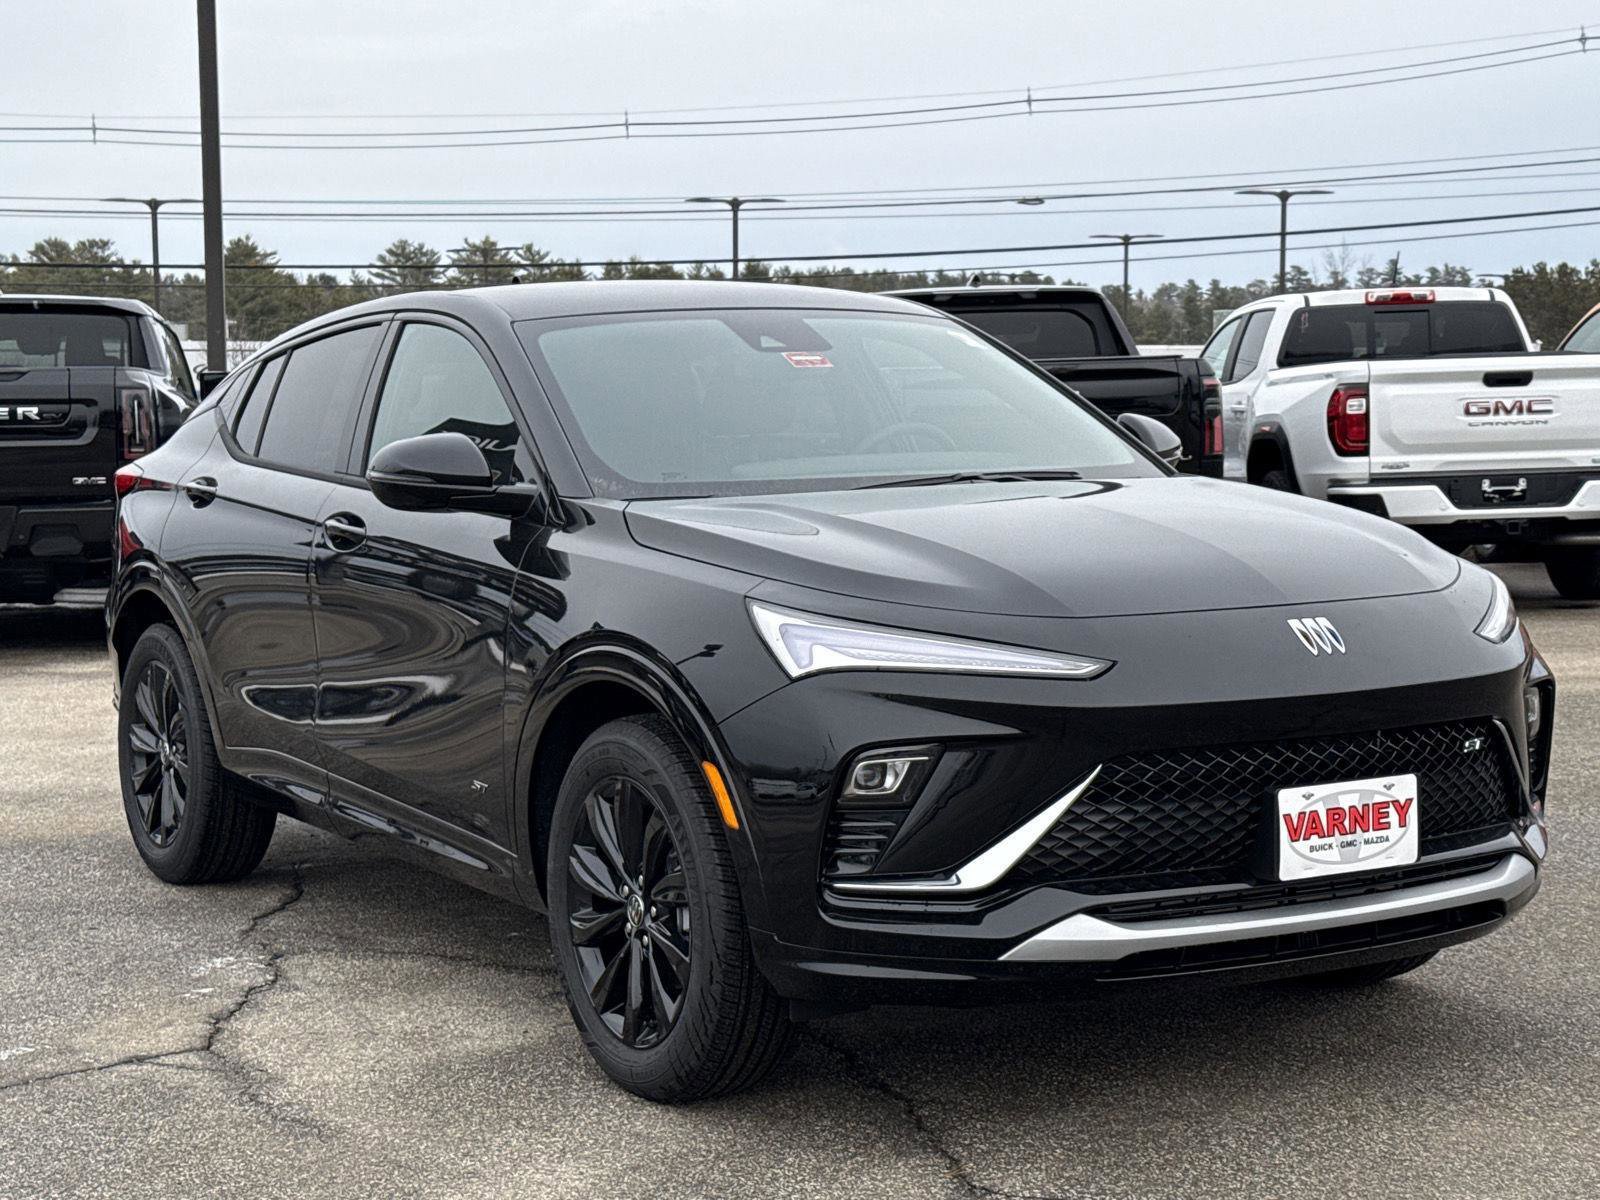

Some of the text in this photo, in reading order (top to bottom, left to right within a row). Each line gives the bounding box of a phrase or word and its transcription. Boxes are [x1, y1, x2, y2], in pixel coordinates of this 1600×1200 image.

[1464, 399, 1554, 417] GMC
[1468, 419, 1548, 427] CANYON
[1283, 797, 1414, 843] VARNEY
[1309, 834, 1390, 853] BUICK GMC MAZDA
